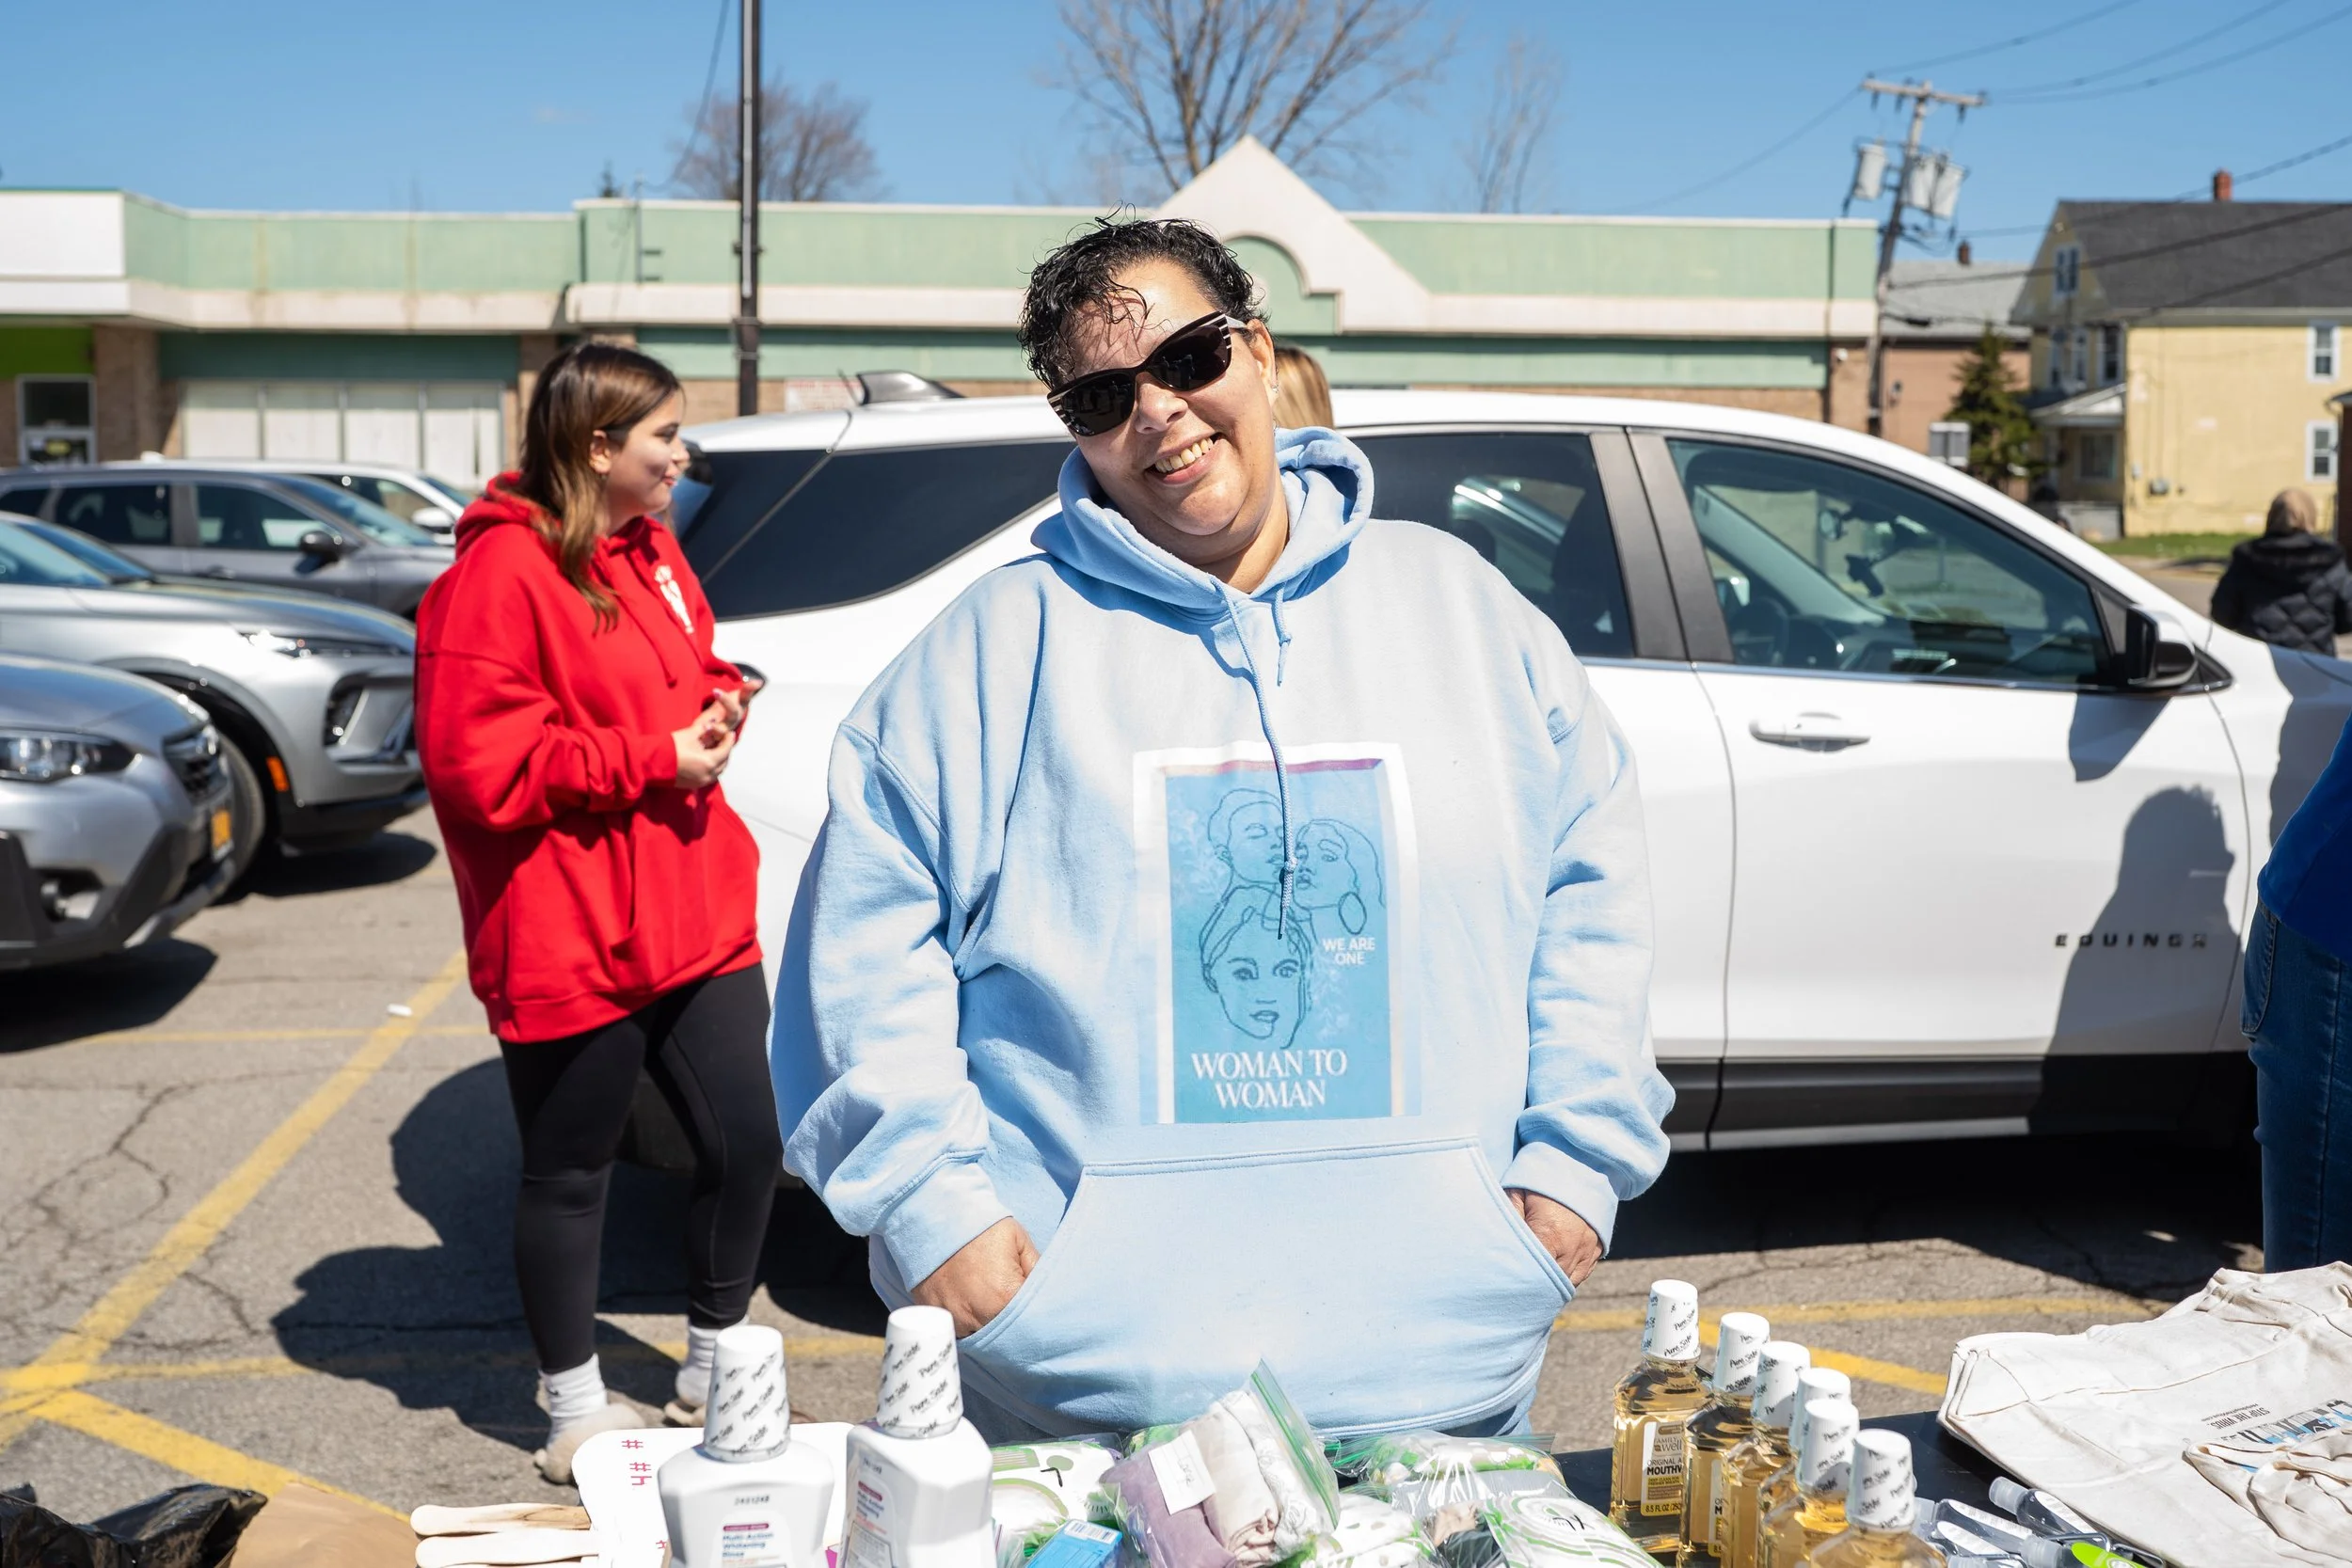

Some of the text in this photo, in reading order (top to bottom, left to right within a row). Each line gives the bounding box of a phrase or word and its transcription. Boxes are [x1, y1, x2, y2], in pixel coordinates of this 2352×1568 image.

[1322, 937, 1376, 952] WE ARE
[1334, 952, 1365, 966] ONE
[1191, 1048, 1347, 1080] WOMAN TO
[1215, 1080, 1326, 1109] WOMAN
[2235, 1411, 2252, 1423] THE
[2250, 1406, 2270, 1418] STOP
[1646, 1458, 1675, 1467] ORIGINAL
